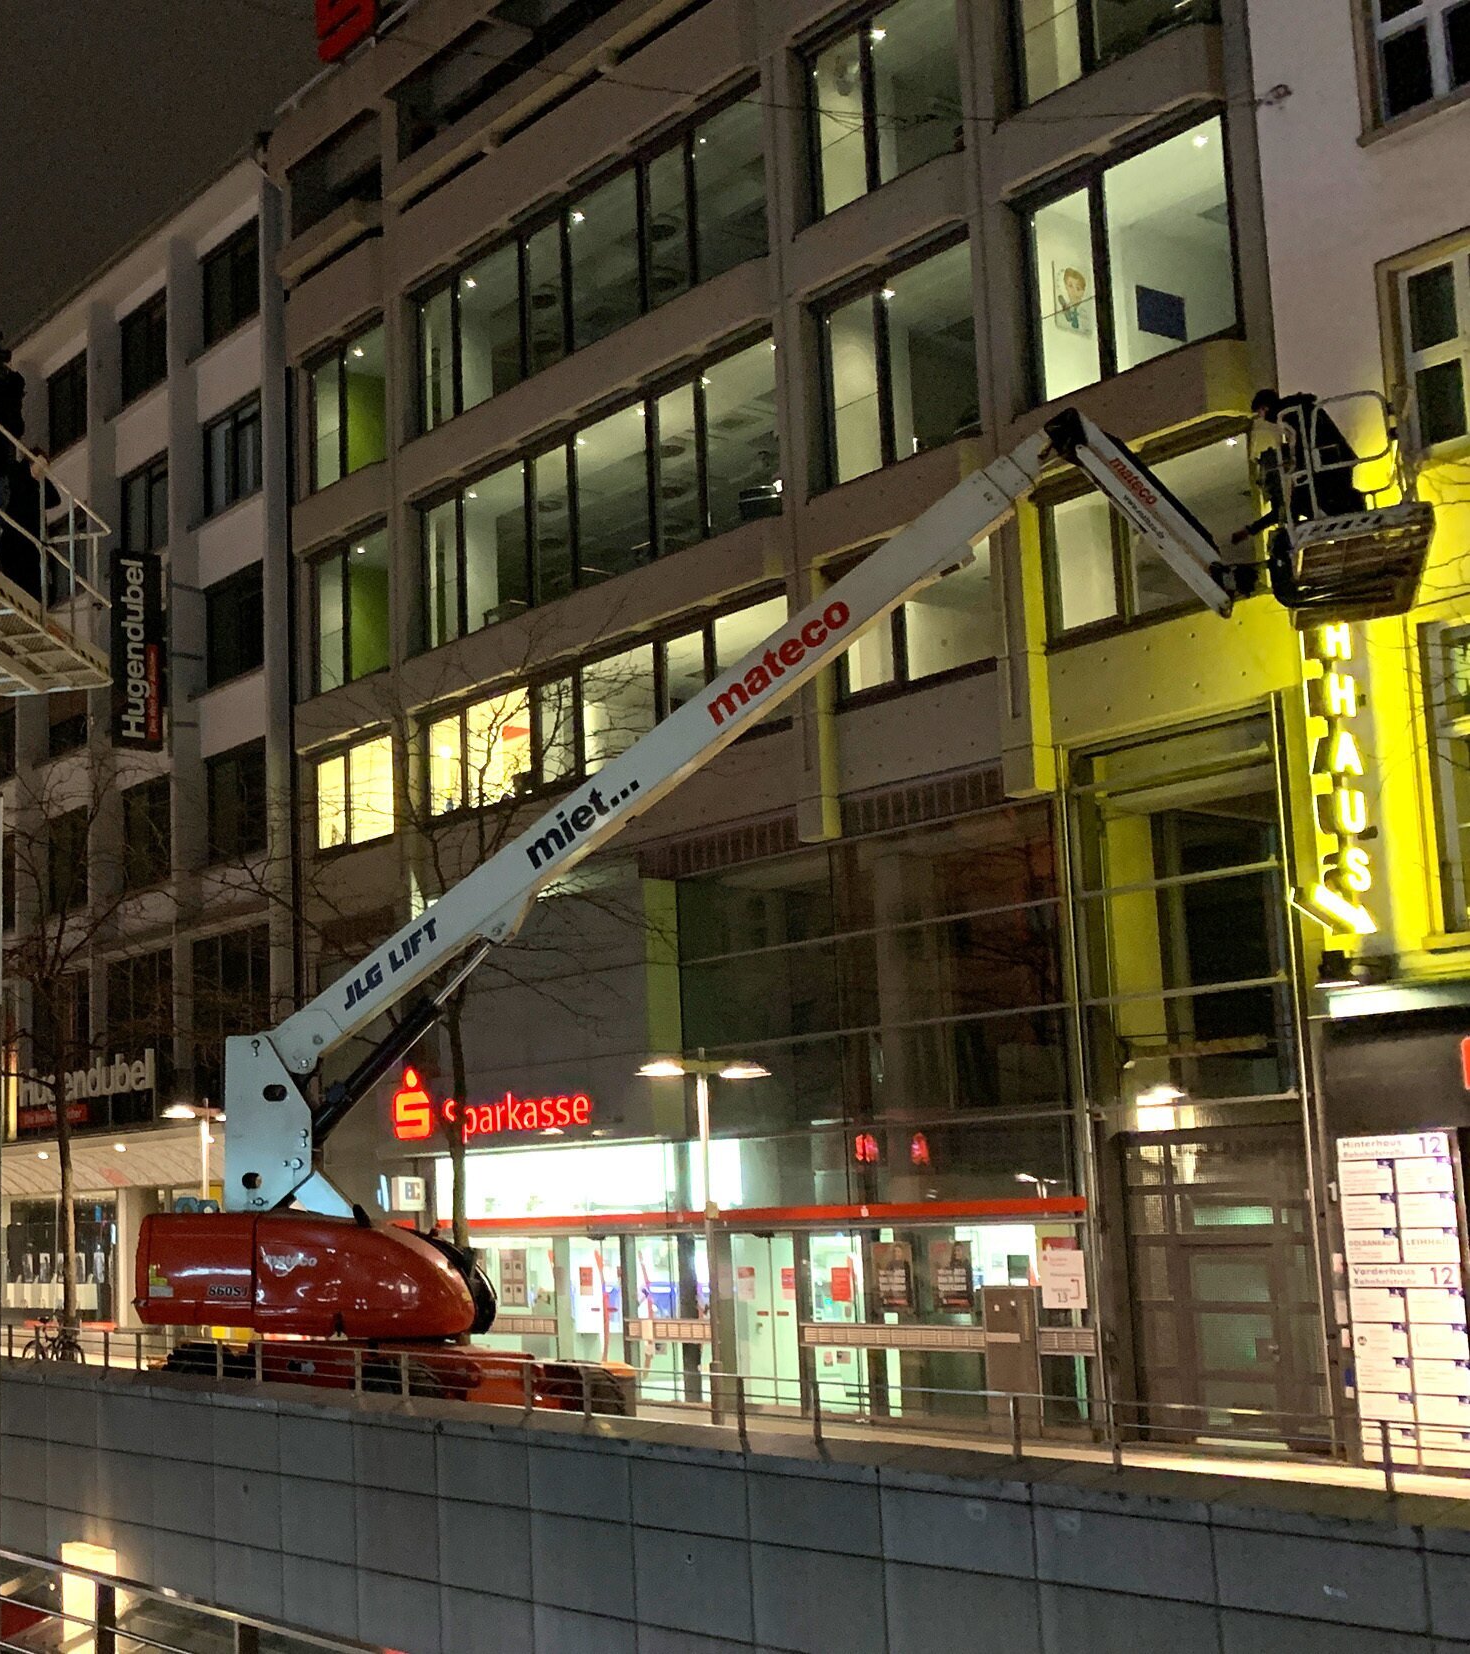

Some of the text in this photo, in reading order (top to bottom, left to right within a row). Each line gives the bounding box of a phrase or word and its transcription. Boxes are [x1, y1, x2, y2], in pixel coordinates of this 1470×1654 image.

[1110, 457, 1157, 505] mateco
[120, 559, 150, 739] Hugendubel
[526, 601, 850, 870] miet... mateco
[344, 917, 437, 1011] JLG LIFT
[1419, 1136, 1441, 1154] 12
[1430, 1267, 1454, 1285] 12
